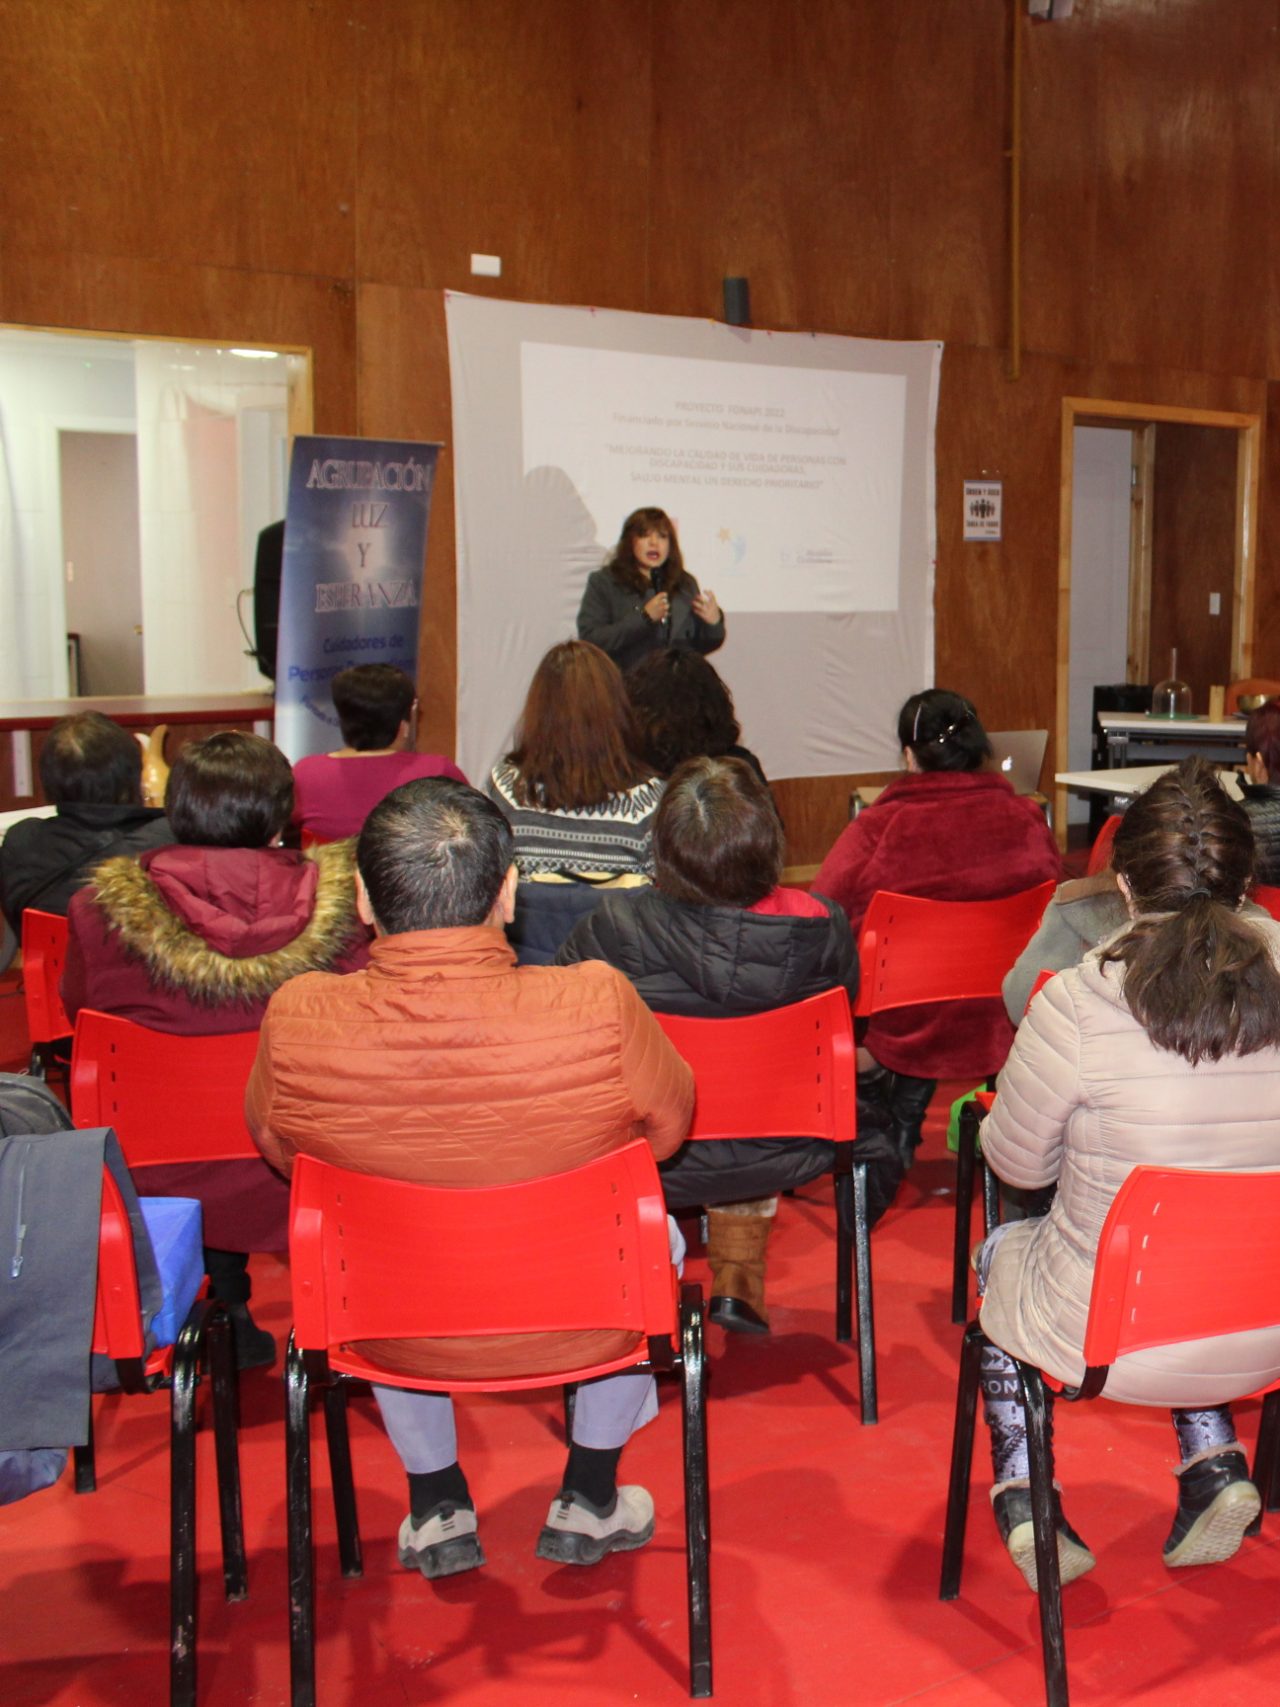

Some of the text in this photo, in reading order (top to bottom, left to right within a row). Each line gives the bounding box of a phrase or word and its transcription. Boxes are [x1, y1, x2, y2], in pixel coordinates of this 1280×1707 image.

[675, 401, 723, 413] PROYECTO
[744, 453, 765, 462] VIDA
[780, 455, 826, 465] PERSONAS
[306, 457, 431, 492] AGRUPACIÓN
[351, 501, 390, 529] LUZ
[357, 542, 372, 569] Y
[315, 579, 417, 613] ESPERANZA
[323, 633, 405, 654] Cuidadores de
